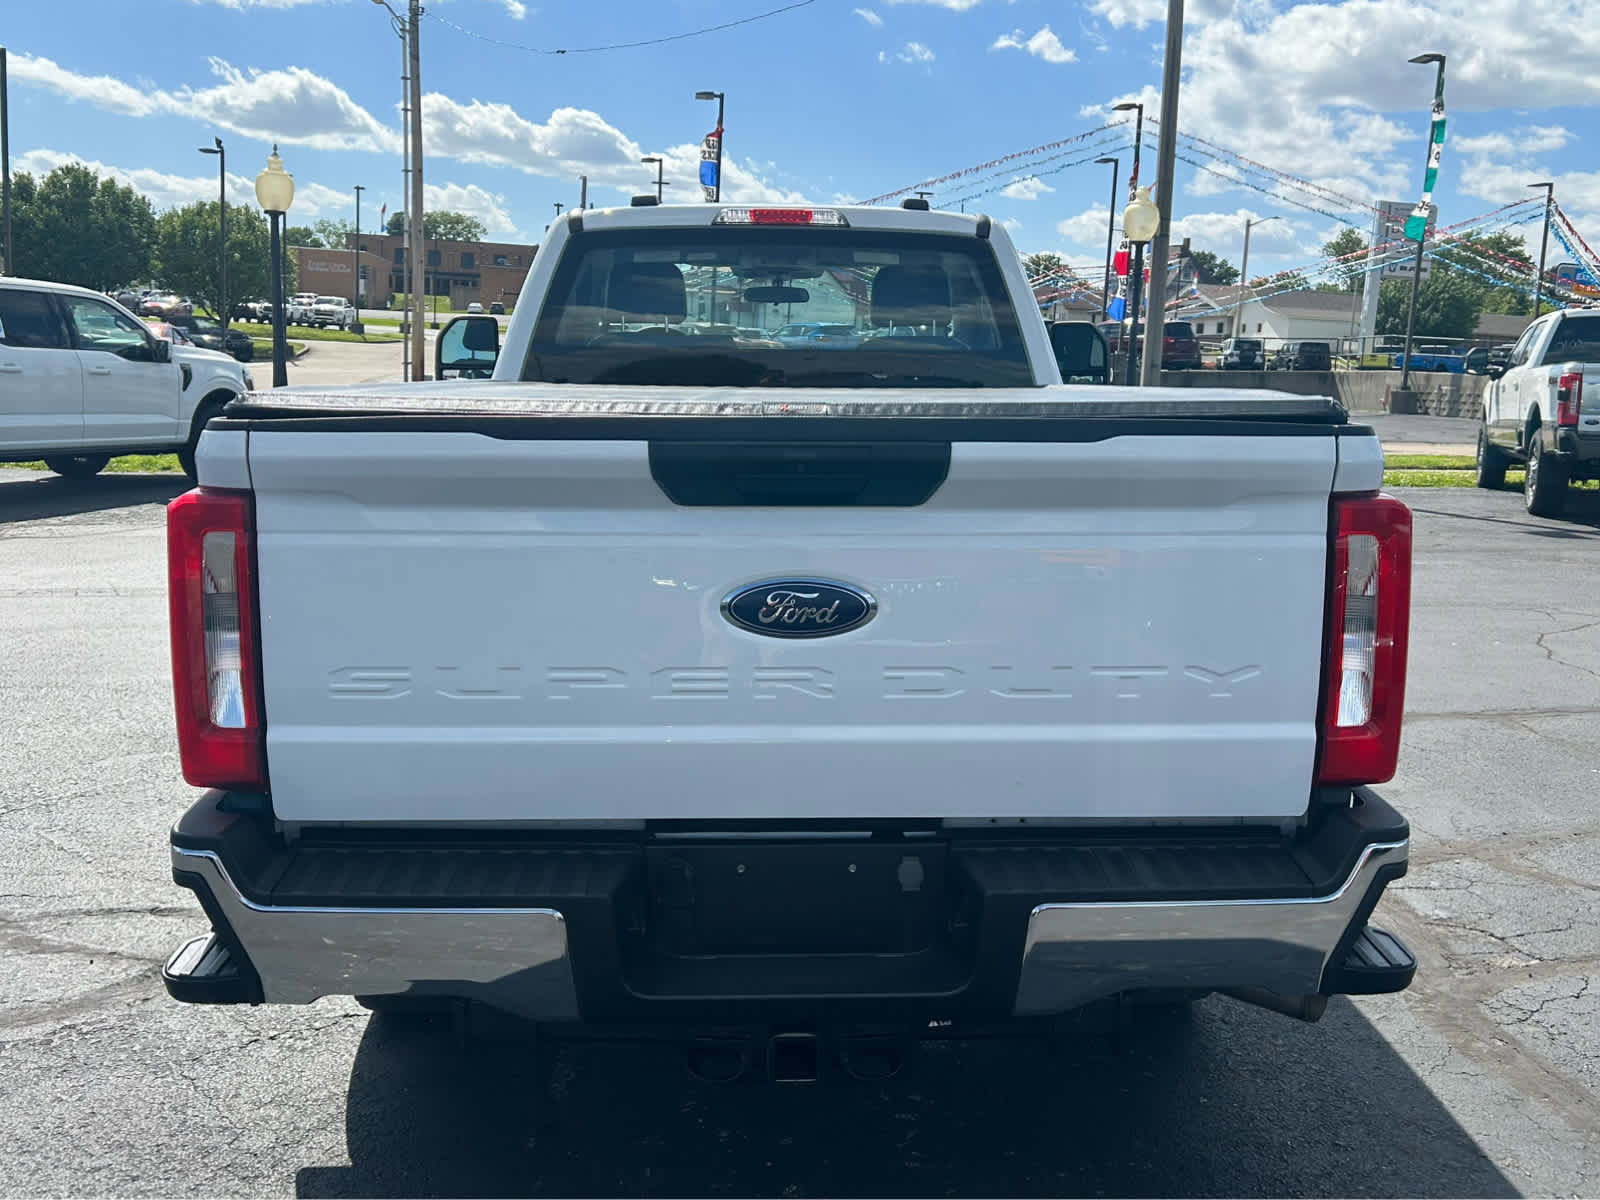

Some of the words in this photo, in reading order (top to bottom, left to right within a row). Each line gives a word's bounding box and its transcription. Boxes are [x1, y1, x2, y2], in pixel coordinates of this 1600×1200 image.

[758, 590, 840, 624] Ford
[328, 666, 834, 699] SUPER
[883, 665, 1262, 698] DUTY
